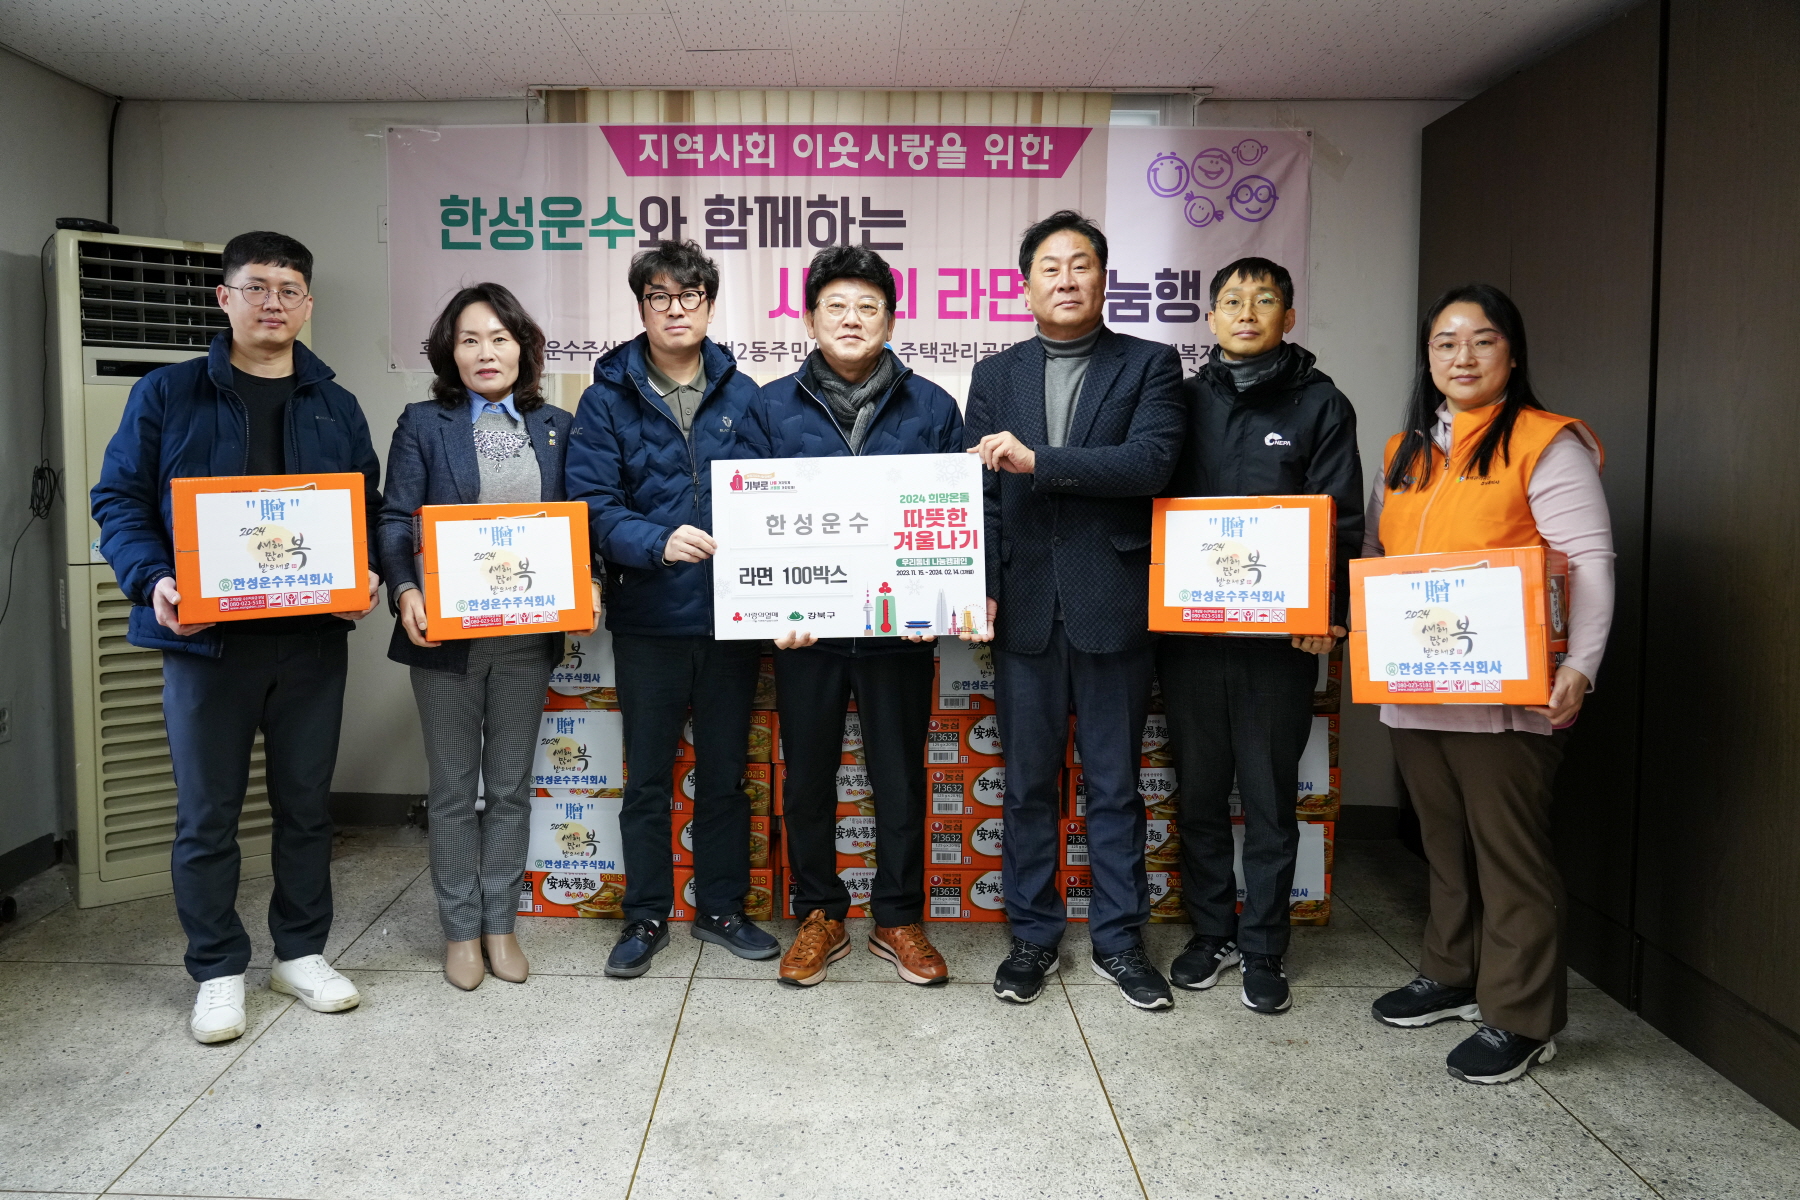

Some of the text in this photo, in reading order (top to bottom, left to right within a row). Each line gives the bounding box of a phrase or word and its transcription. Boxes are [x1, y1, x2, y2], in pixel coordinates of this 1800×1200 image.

[638, 131, 1054, 171] 지역사회 이웃사랑을 위한
[439, 193, 907, 251] 한성운수와 함께하는
[937, 267, 1034, 322] 라면
[744, 481, 769, 491] 기부로
[899, 492, 970, 504] 2024 희망온돌
[903, 507, 968, 529] 따뜻한
[239, 526, 267, 537] 2024
[257, 540, 284, 550] 새해
[893, 529, 979, 551] 겨울나기
[284, 532, 312, 571] 복
[1200, 542, 1226, 552] 2024
[473, 551, 497, 561] 2024
[1240, 549, 1267, 588] 복
[512, 557, 537, 593] 복
[739, 565, 848, 587] 라면 100박스
[232, 573, 334, 590] 한성운수주식회사
[1191, 590, 1286, 603] 한성운수주식회사
[467, 594, 556, 612] 한성운수주식회사
[807, 611, 836, 620] 강북구
[1403, 609, 1431, 620] 2024
[1421, 623, 1448, 634] 새해
[1449, 615, 1478, 658] 복
[566, 640, 586, 671] 복
[1398, 660, 1503, 675] 한성운수주식회사
[940, 722, 960, 730] 농심
[929, 731, 958, 742] 가3632
[536, 775, 608, 785] 한성운수주식회사
[945, 773, 964, 781] 농심
[933, 783, 963, 793] 가3632
[943, 823, 962, 831] 농심
[932, 833, 961, 843] 가3632
[544, 859, 616, 870] 한성운수주식회사
[942, 877, 961, 885] 농심
[931, 887, 960, 897] 가3632
